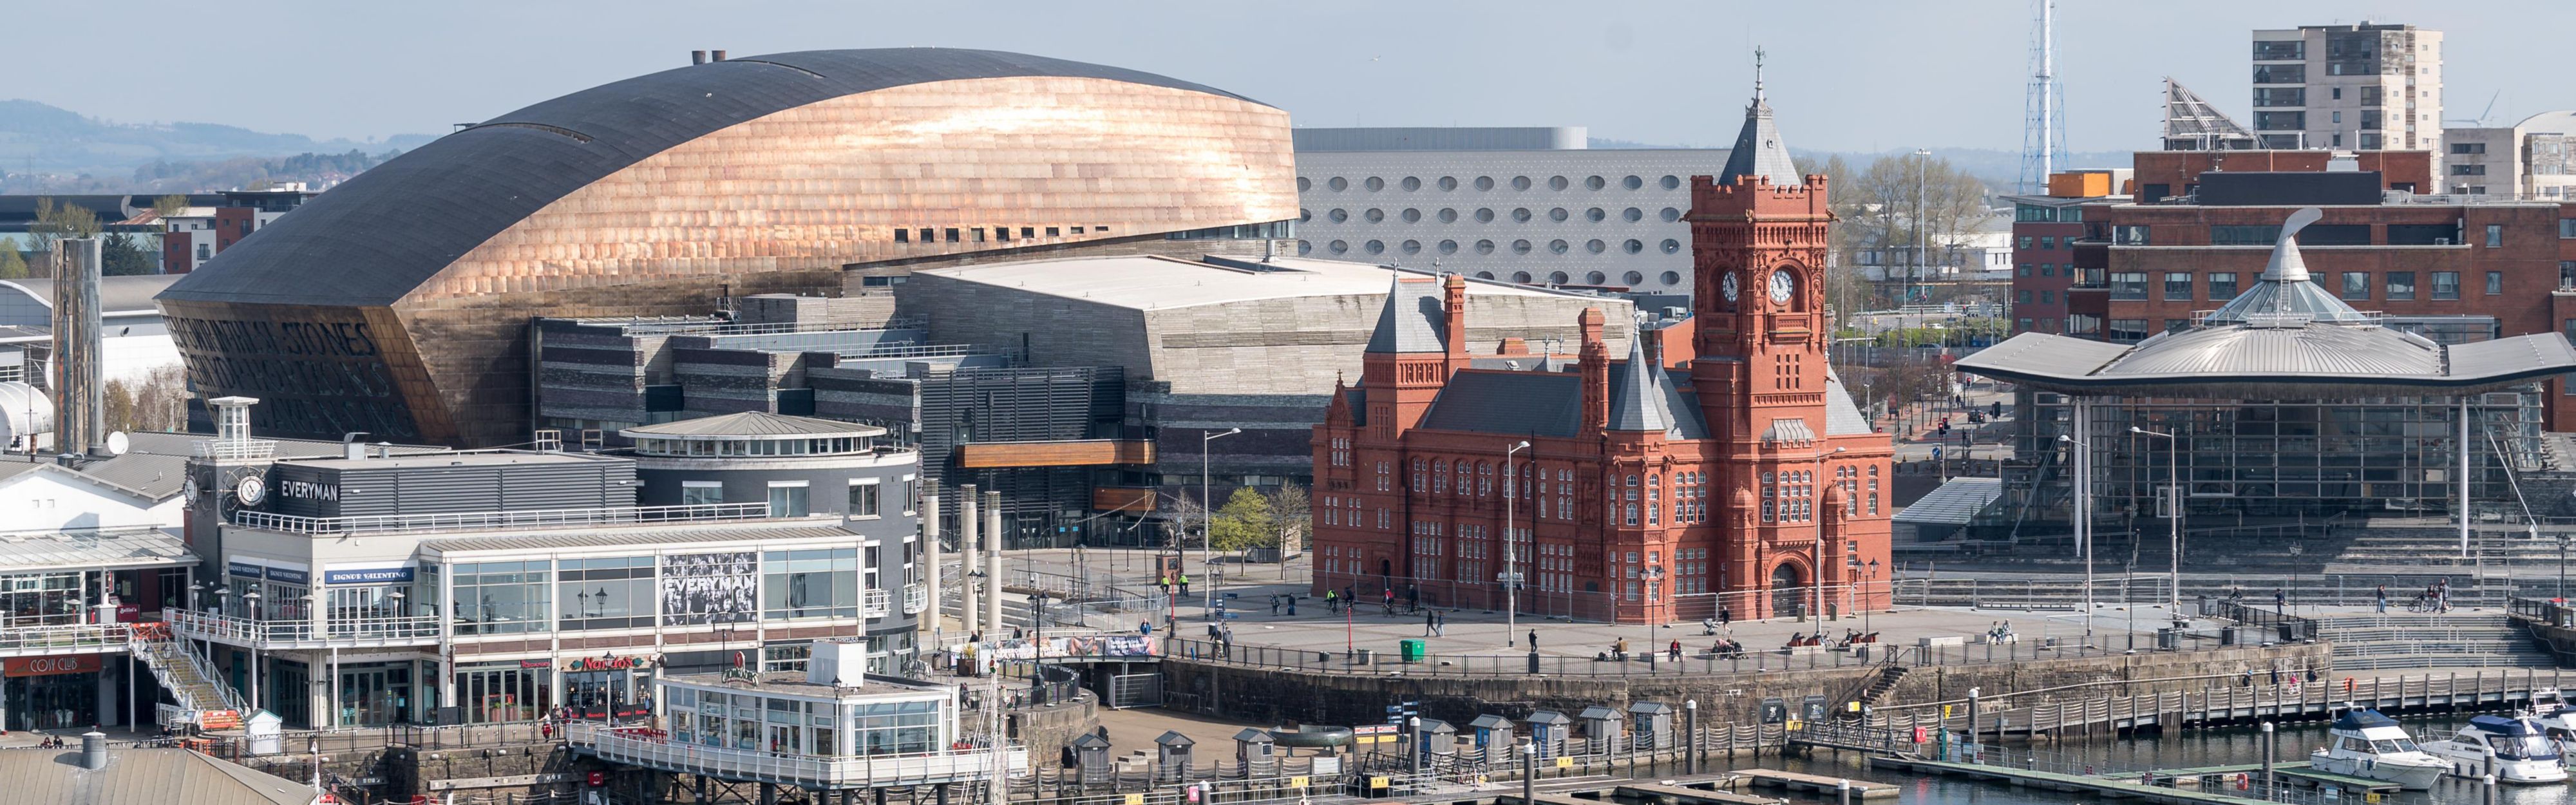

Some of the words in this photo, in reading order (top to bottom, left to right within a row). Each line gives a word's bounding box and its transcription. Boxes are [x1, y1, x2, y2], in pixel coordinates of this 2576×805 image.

[281, 322, 375, 356] STONES
[242, 359, 390, 397] HORIZONS
[282, 480, 337, 502] EVERYMAN
[665, 575, 755, 592] EVERYMAN
[30, 659, 55, 672] COSY
[58, 658, 77, 670] CLUB
